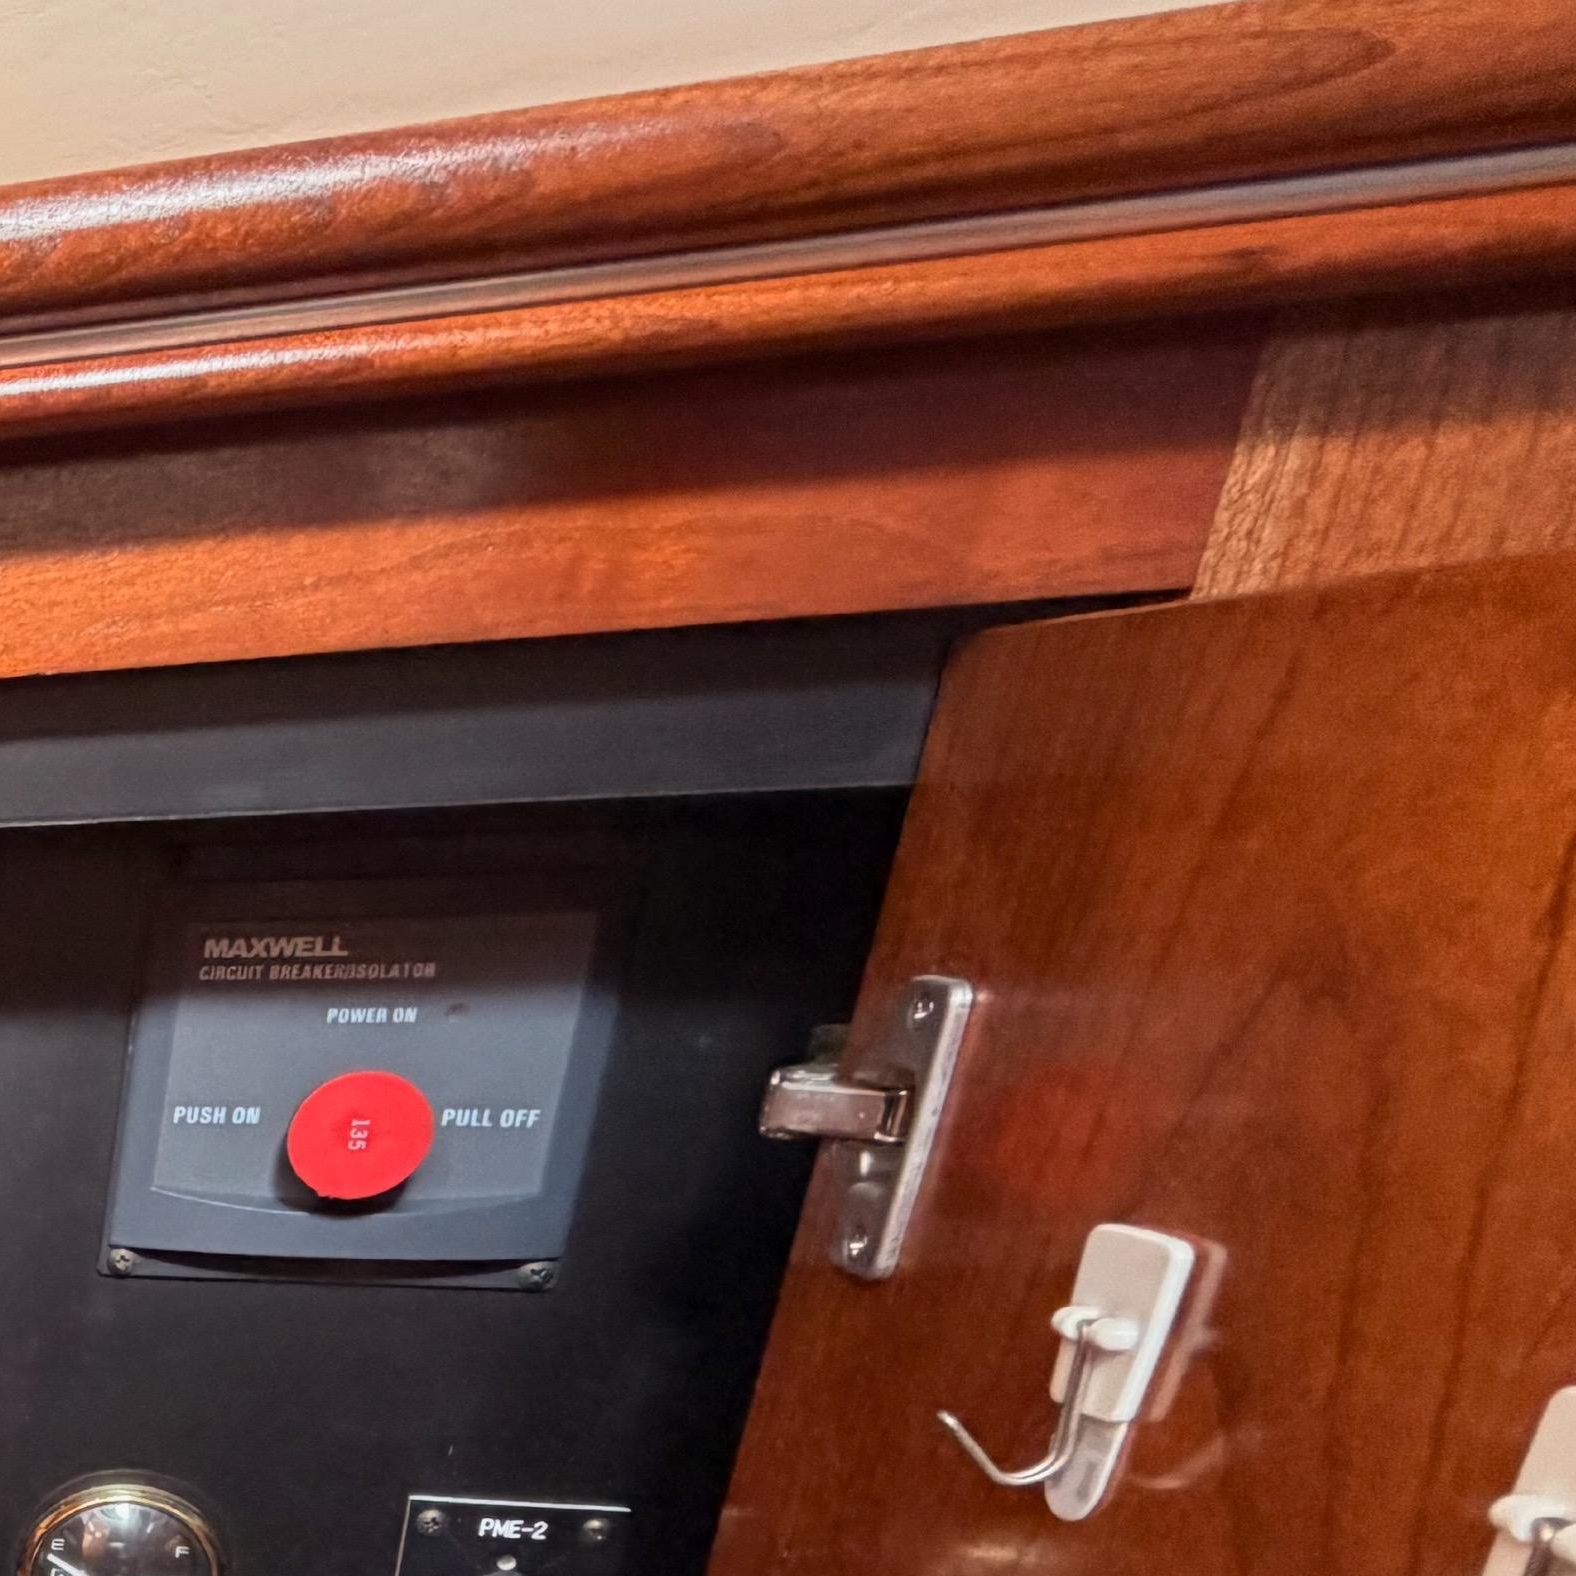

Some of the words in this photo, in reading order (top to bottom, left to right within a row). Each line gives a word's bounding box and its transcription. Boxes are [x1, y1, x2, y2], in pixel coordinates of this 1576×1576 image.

[203, 936, 349, 958] MAXWELL
[198, 964, 264, 980] CIRCUIT
[326, 1007, 387, 1024] POWER
[392, 1007, 417, 1023] ON
[173, 1106, 226, 1124] PUSH
[231, 1106, 260, 1124] ON
[440, 1108, 492, 1127] PULL
[499, 1109, 541, 1128] OFF
[348, 1119, 371, 1152] 135
[478, 1517, 549, 1540] PME-2
[51, 1538, 65, 1552] E
[174, 1545, 191, 1558] F
